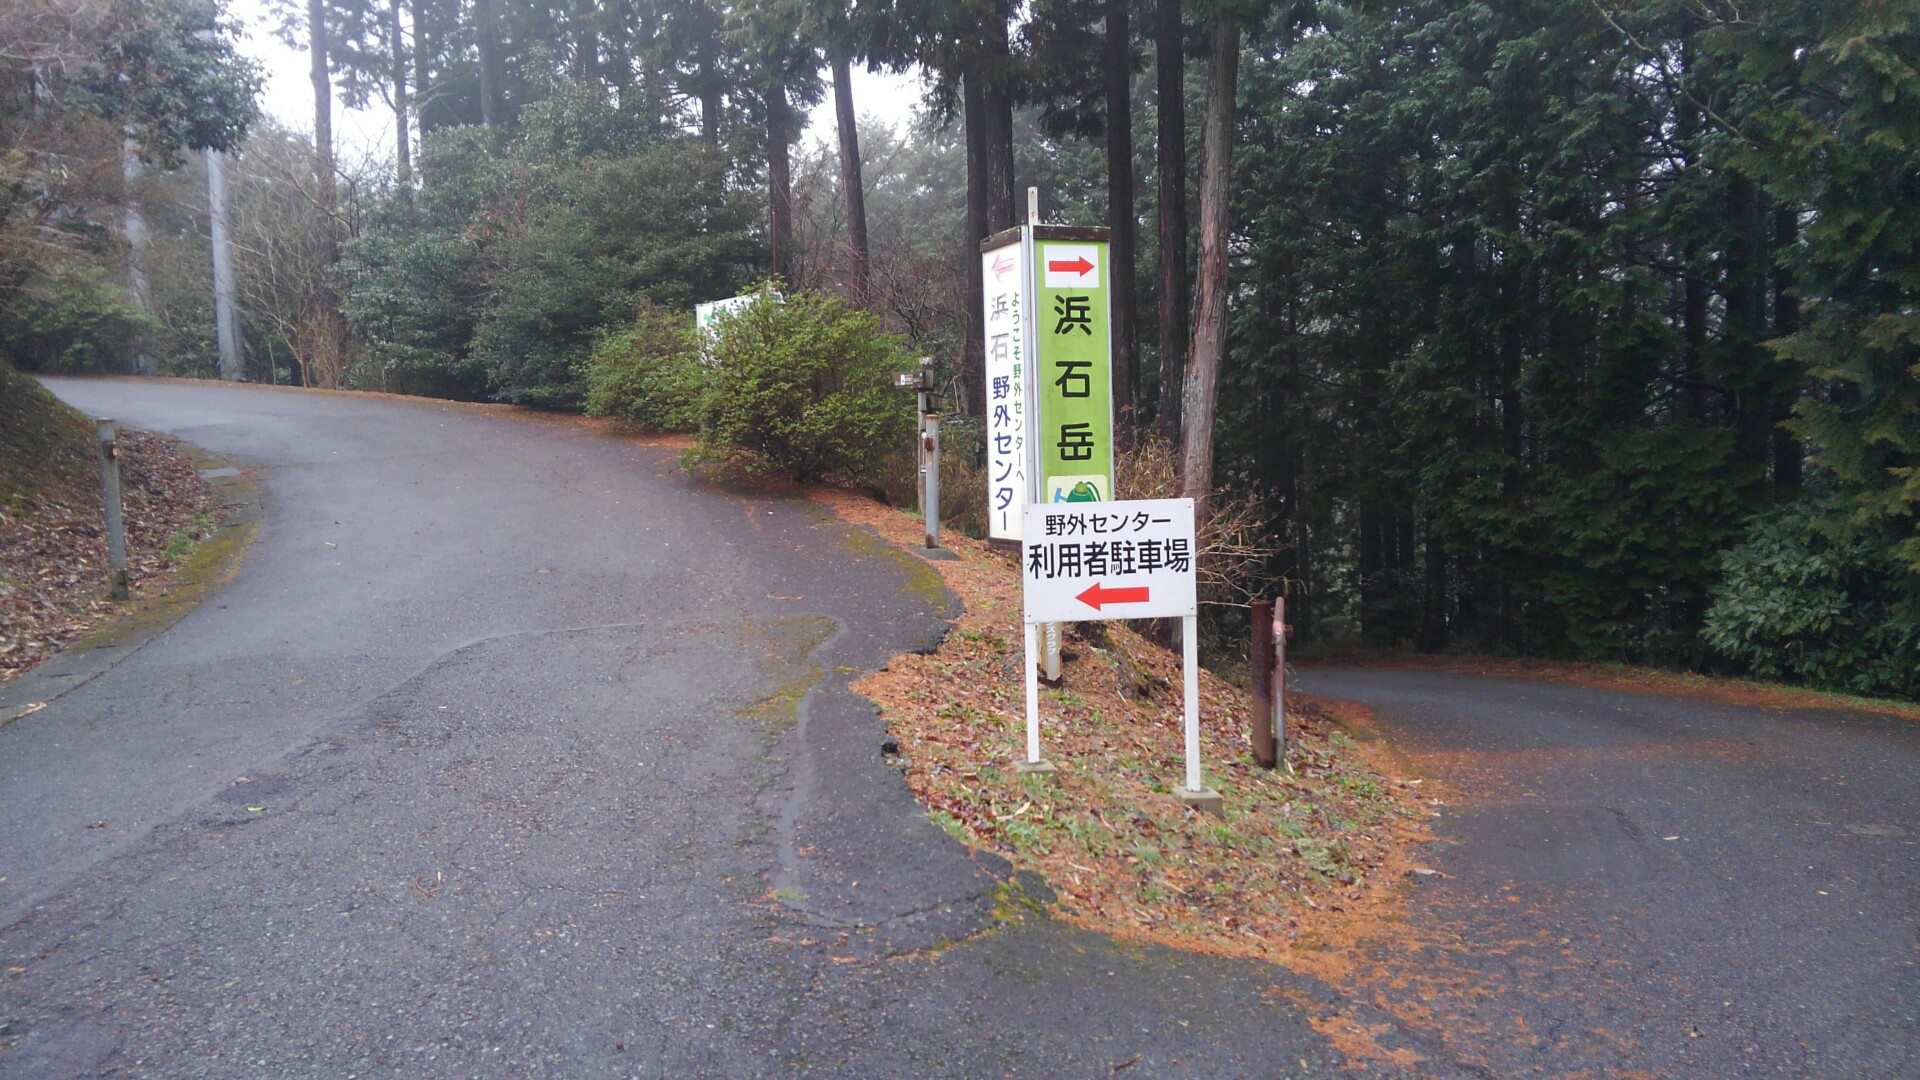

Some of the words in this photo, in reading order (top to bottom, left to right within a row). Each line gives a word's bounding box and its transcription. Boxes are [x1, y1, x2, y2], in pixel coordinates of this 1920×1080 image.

[1011, 291, 1025, 481] ようこそ野外センターへ
[1054, 294, 1095, 461] 浜石岳
[1028, 538, 1190, 579] 利用者駐車場
[1045, 511, 1171, 536] 野外センター
